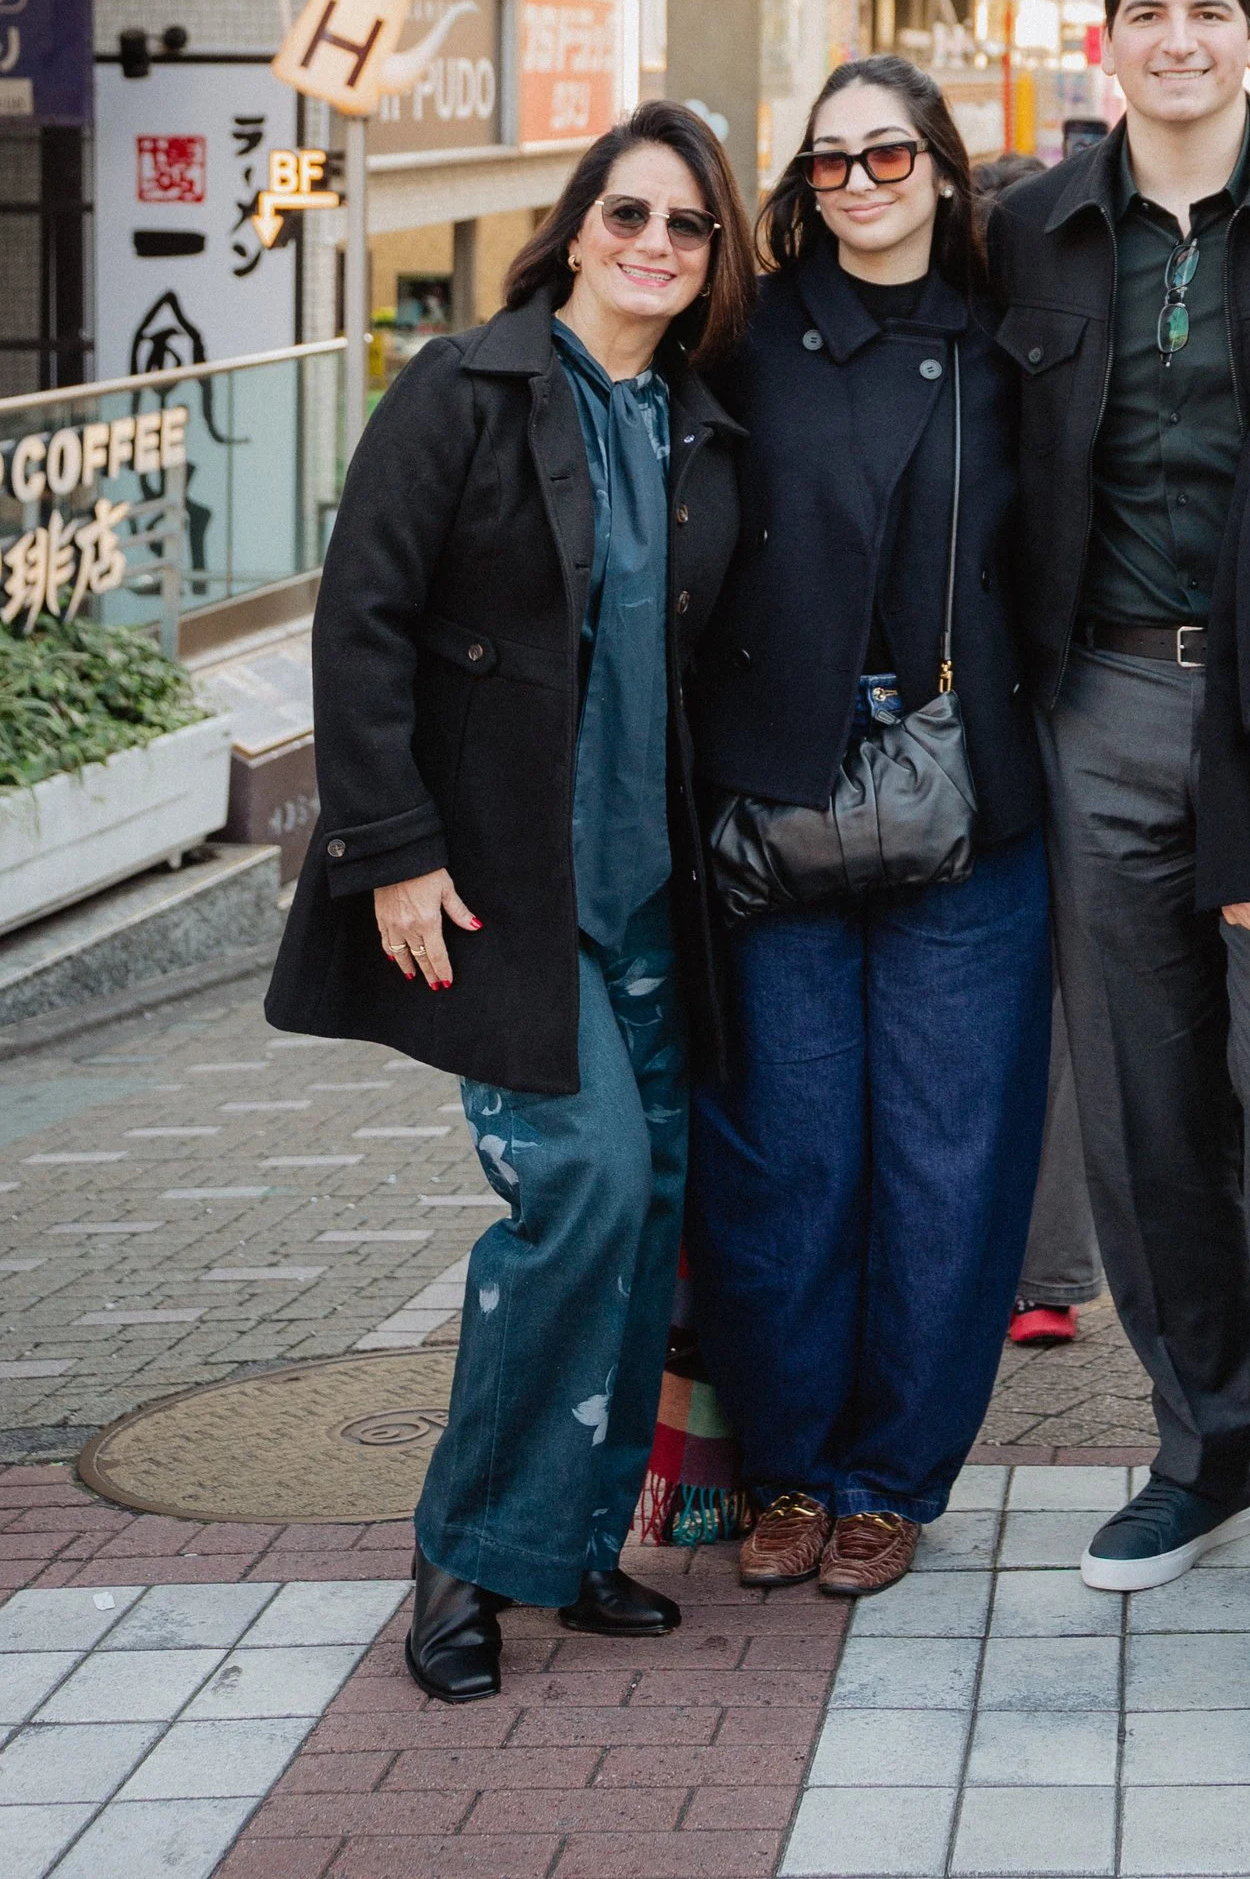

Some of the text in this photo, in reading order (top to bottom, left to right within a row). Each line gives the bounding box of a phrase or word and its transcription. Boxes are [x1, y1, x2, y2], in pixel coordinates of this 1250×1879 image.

[231, 115, 266, 279] ラーメン
[269, 148, 328, 194] BF
[11, 406, 189, 504] COFFEE
[0, 498, 131, 636] 琲店
